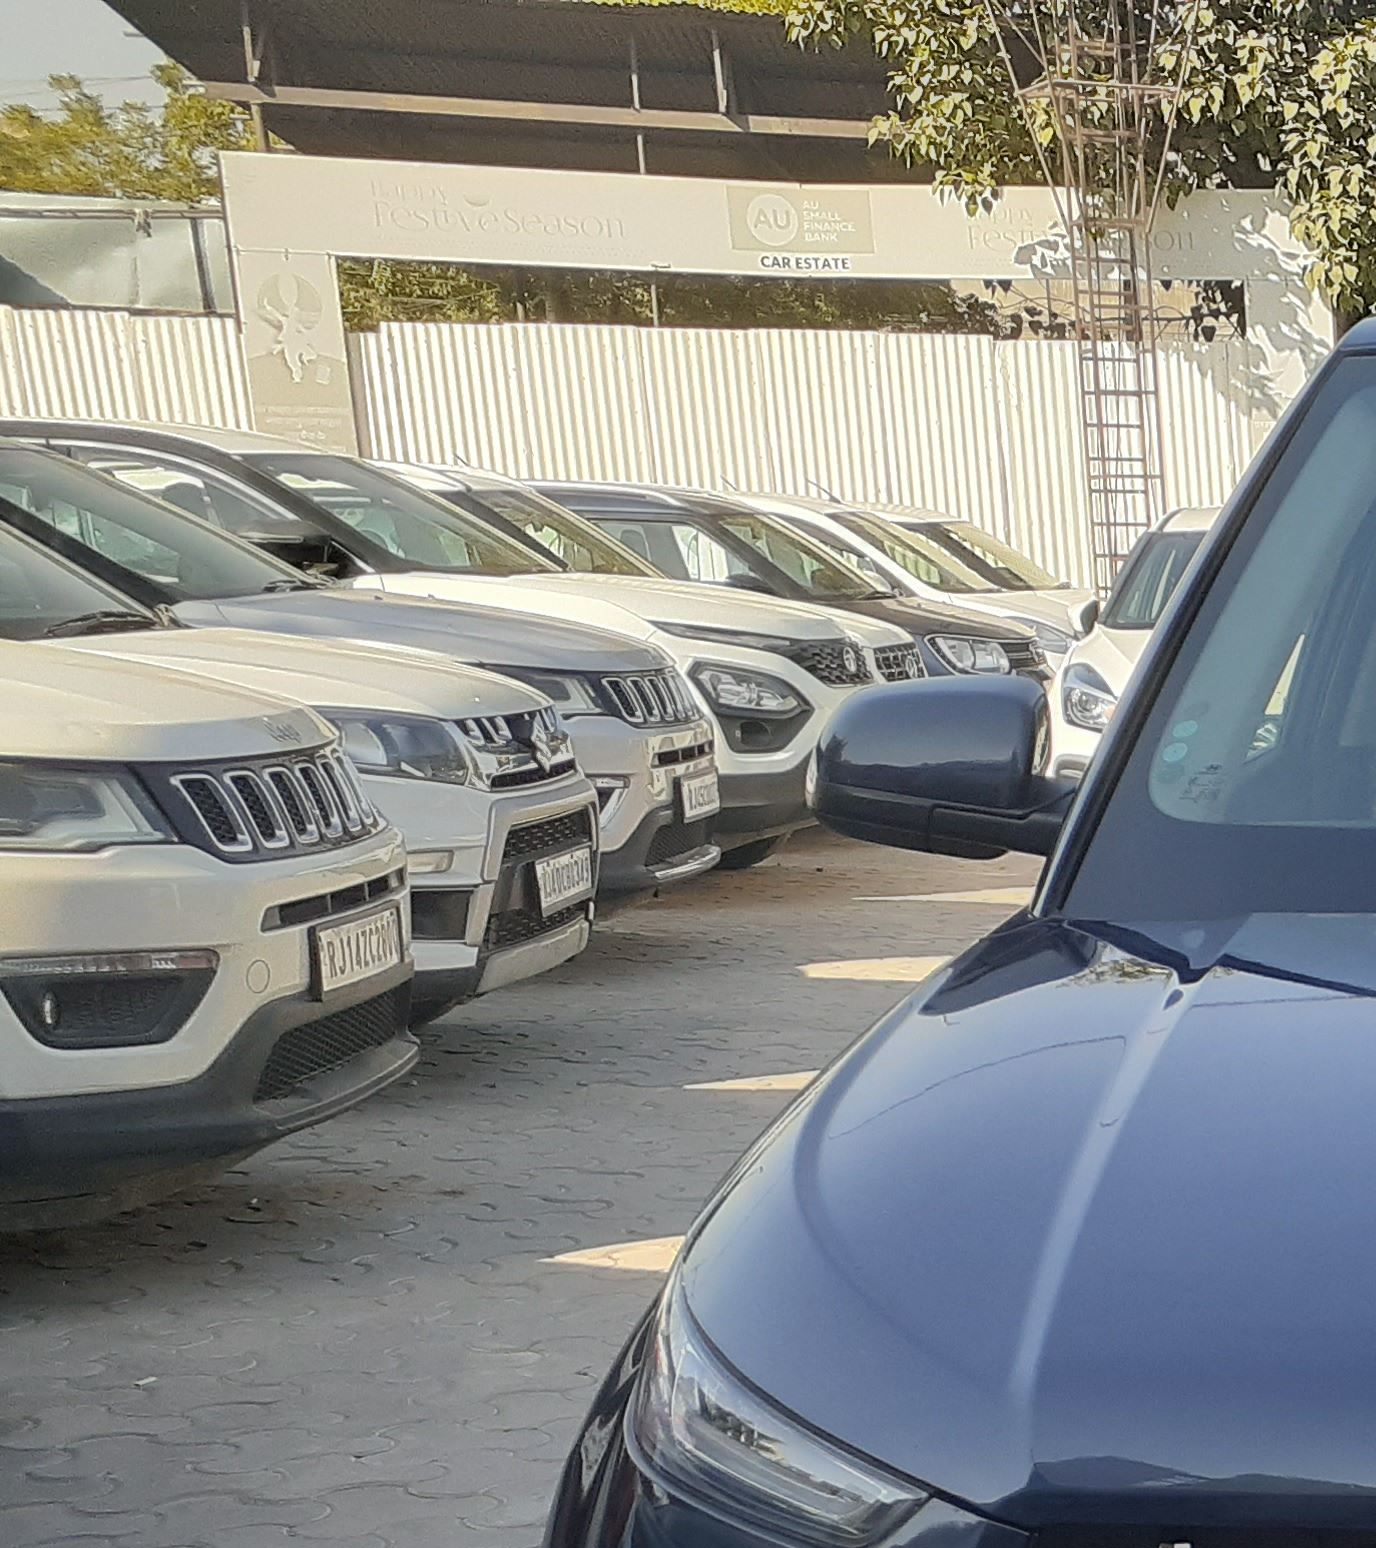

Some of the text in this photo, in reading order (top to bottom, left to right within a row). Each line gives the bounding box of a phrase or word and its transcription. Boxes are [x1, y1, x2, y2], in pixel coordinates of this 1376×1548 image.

[802, 200, 819, 210] AU
[754, 207, 791, 230] AU
[803, 210, 841, 221] SMALL
[803, 221, 857, 232] FINANCE
[804, 232, 839, 242] BANK
[760, 255, 850, 270] CAR ESTATE
